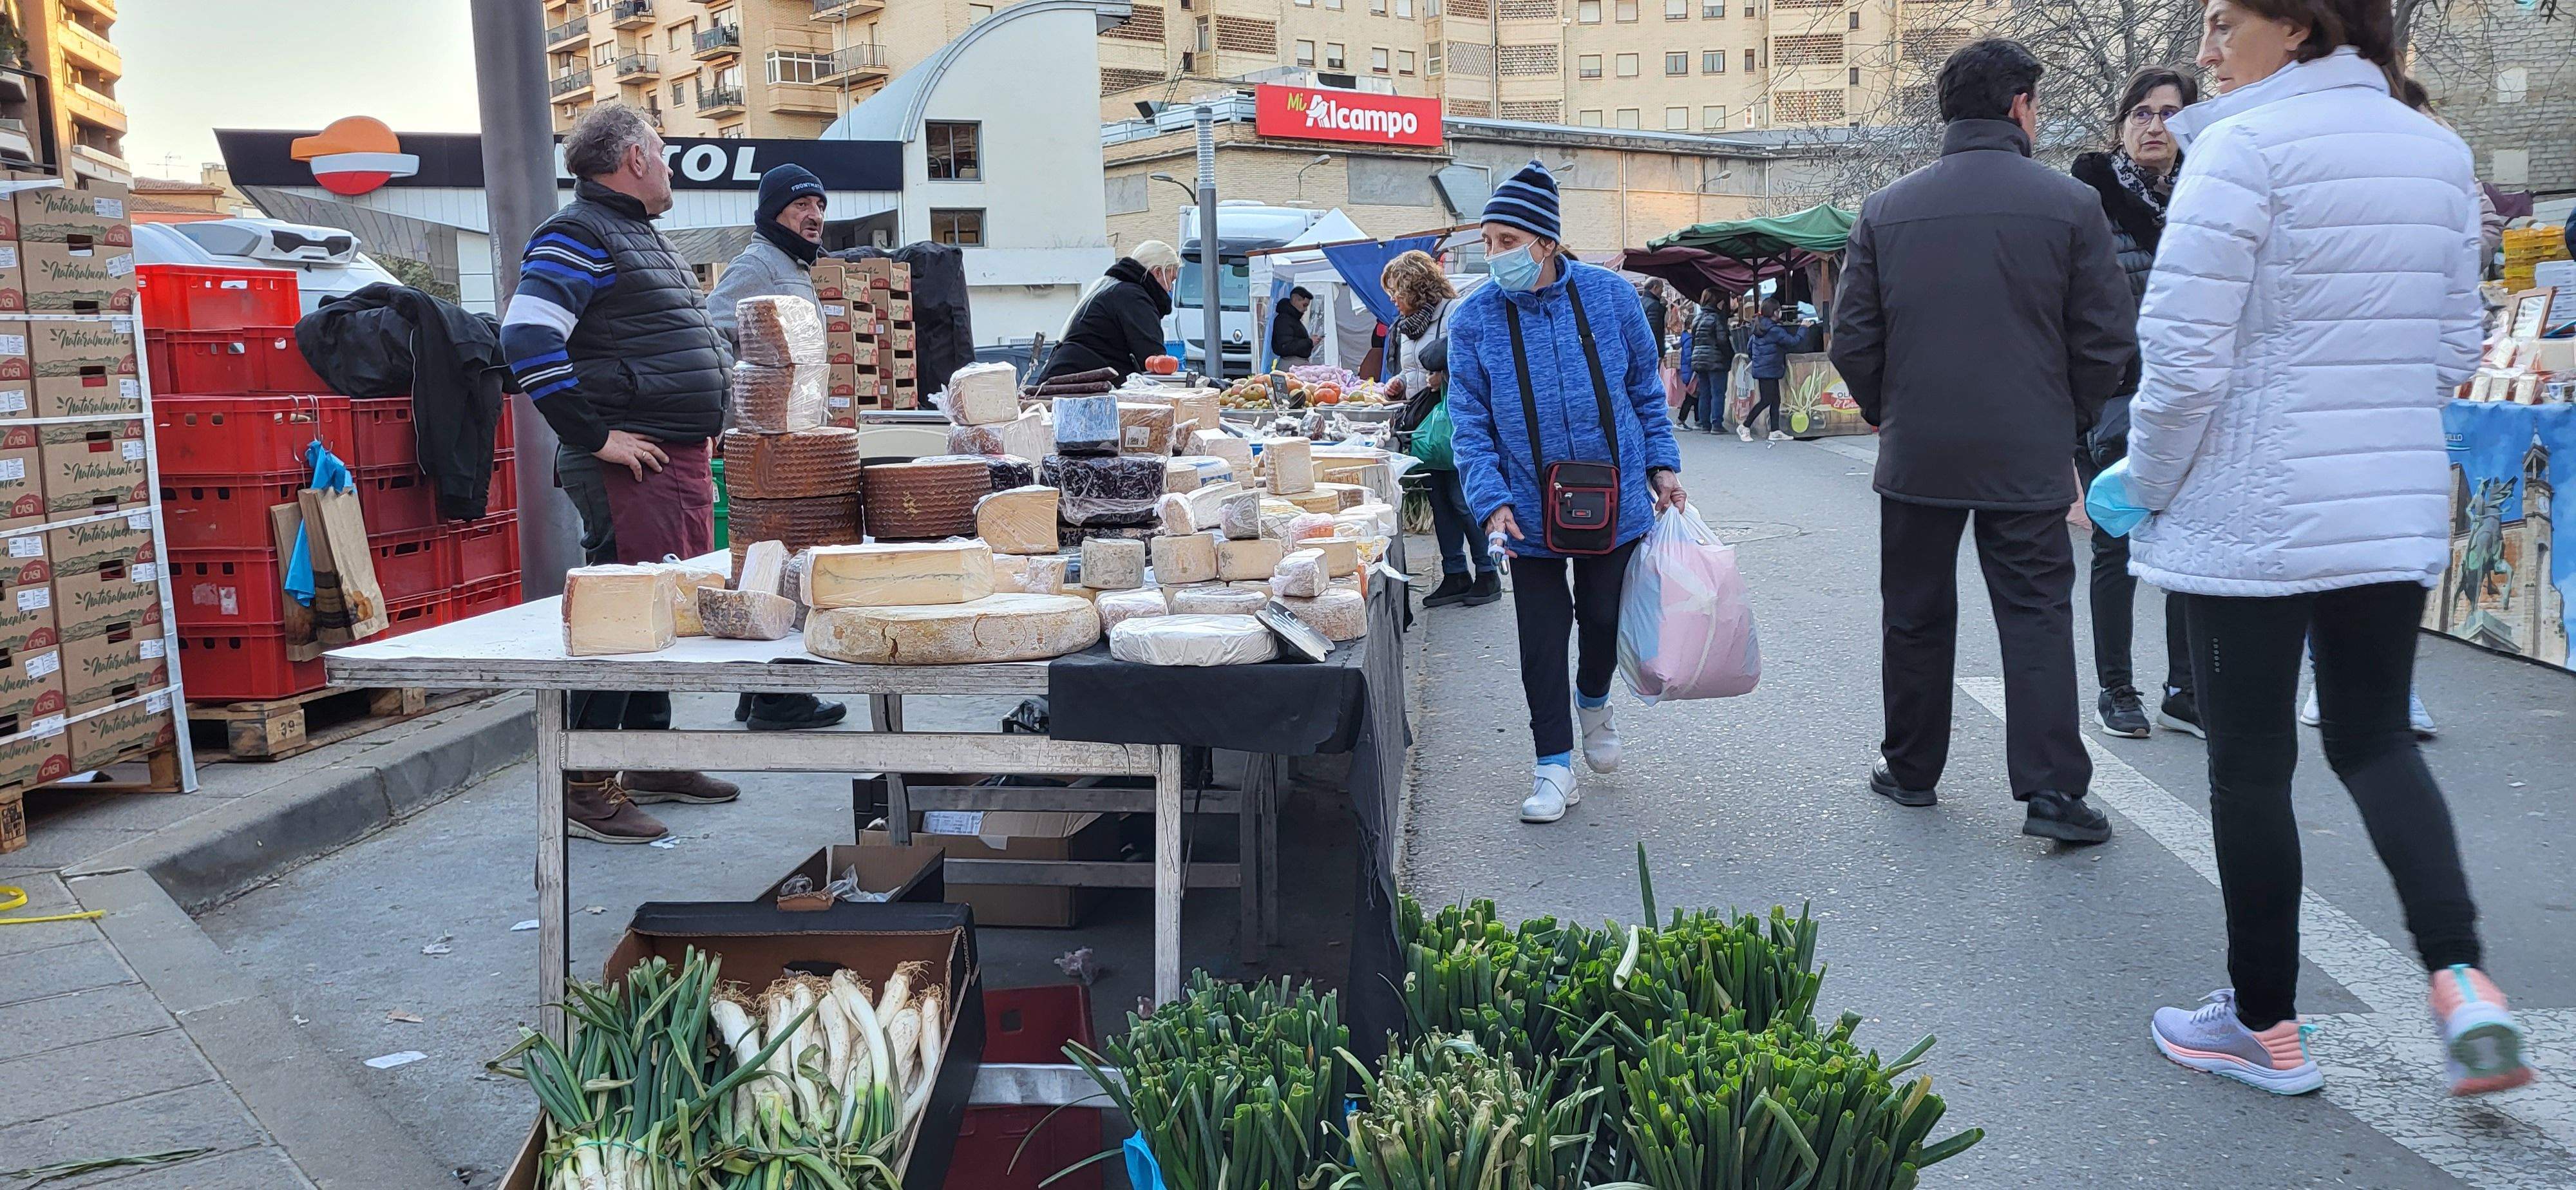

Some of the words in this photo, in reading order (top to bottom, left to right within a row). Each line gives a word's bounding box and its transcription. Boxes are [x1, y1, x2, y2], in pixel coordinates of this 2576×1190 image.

[1287, 92, 1307, 111] Mi
[1306, 94, 1417, 139] Alcampo
[109, 232, 126, 243] CASI
[0, 298, 14, 308] ASI
[114, 297, 129, 307] CAS
[2, 367, 21, 377] CASI
[121, 363, 135, 372] CAS
[128, 426, 142, 436] CAS
[8, 435, 27, 446] CASI
[133, 489, 147, 500] CAS
[15, 503, 34, 515] CASI
[139, 550, 153, 560] CAS
[23, 569, 41, 581] CASI
[146, 612, 160, 622] CAS
[29, 636, 47, 648] CASI
[37, 699, 56, 712] CASI
[280, 720, 295, 736] 39
[42, 763, 61, 777] CASI
